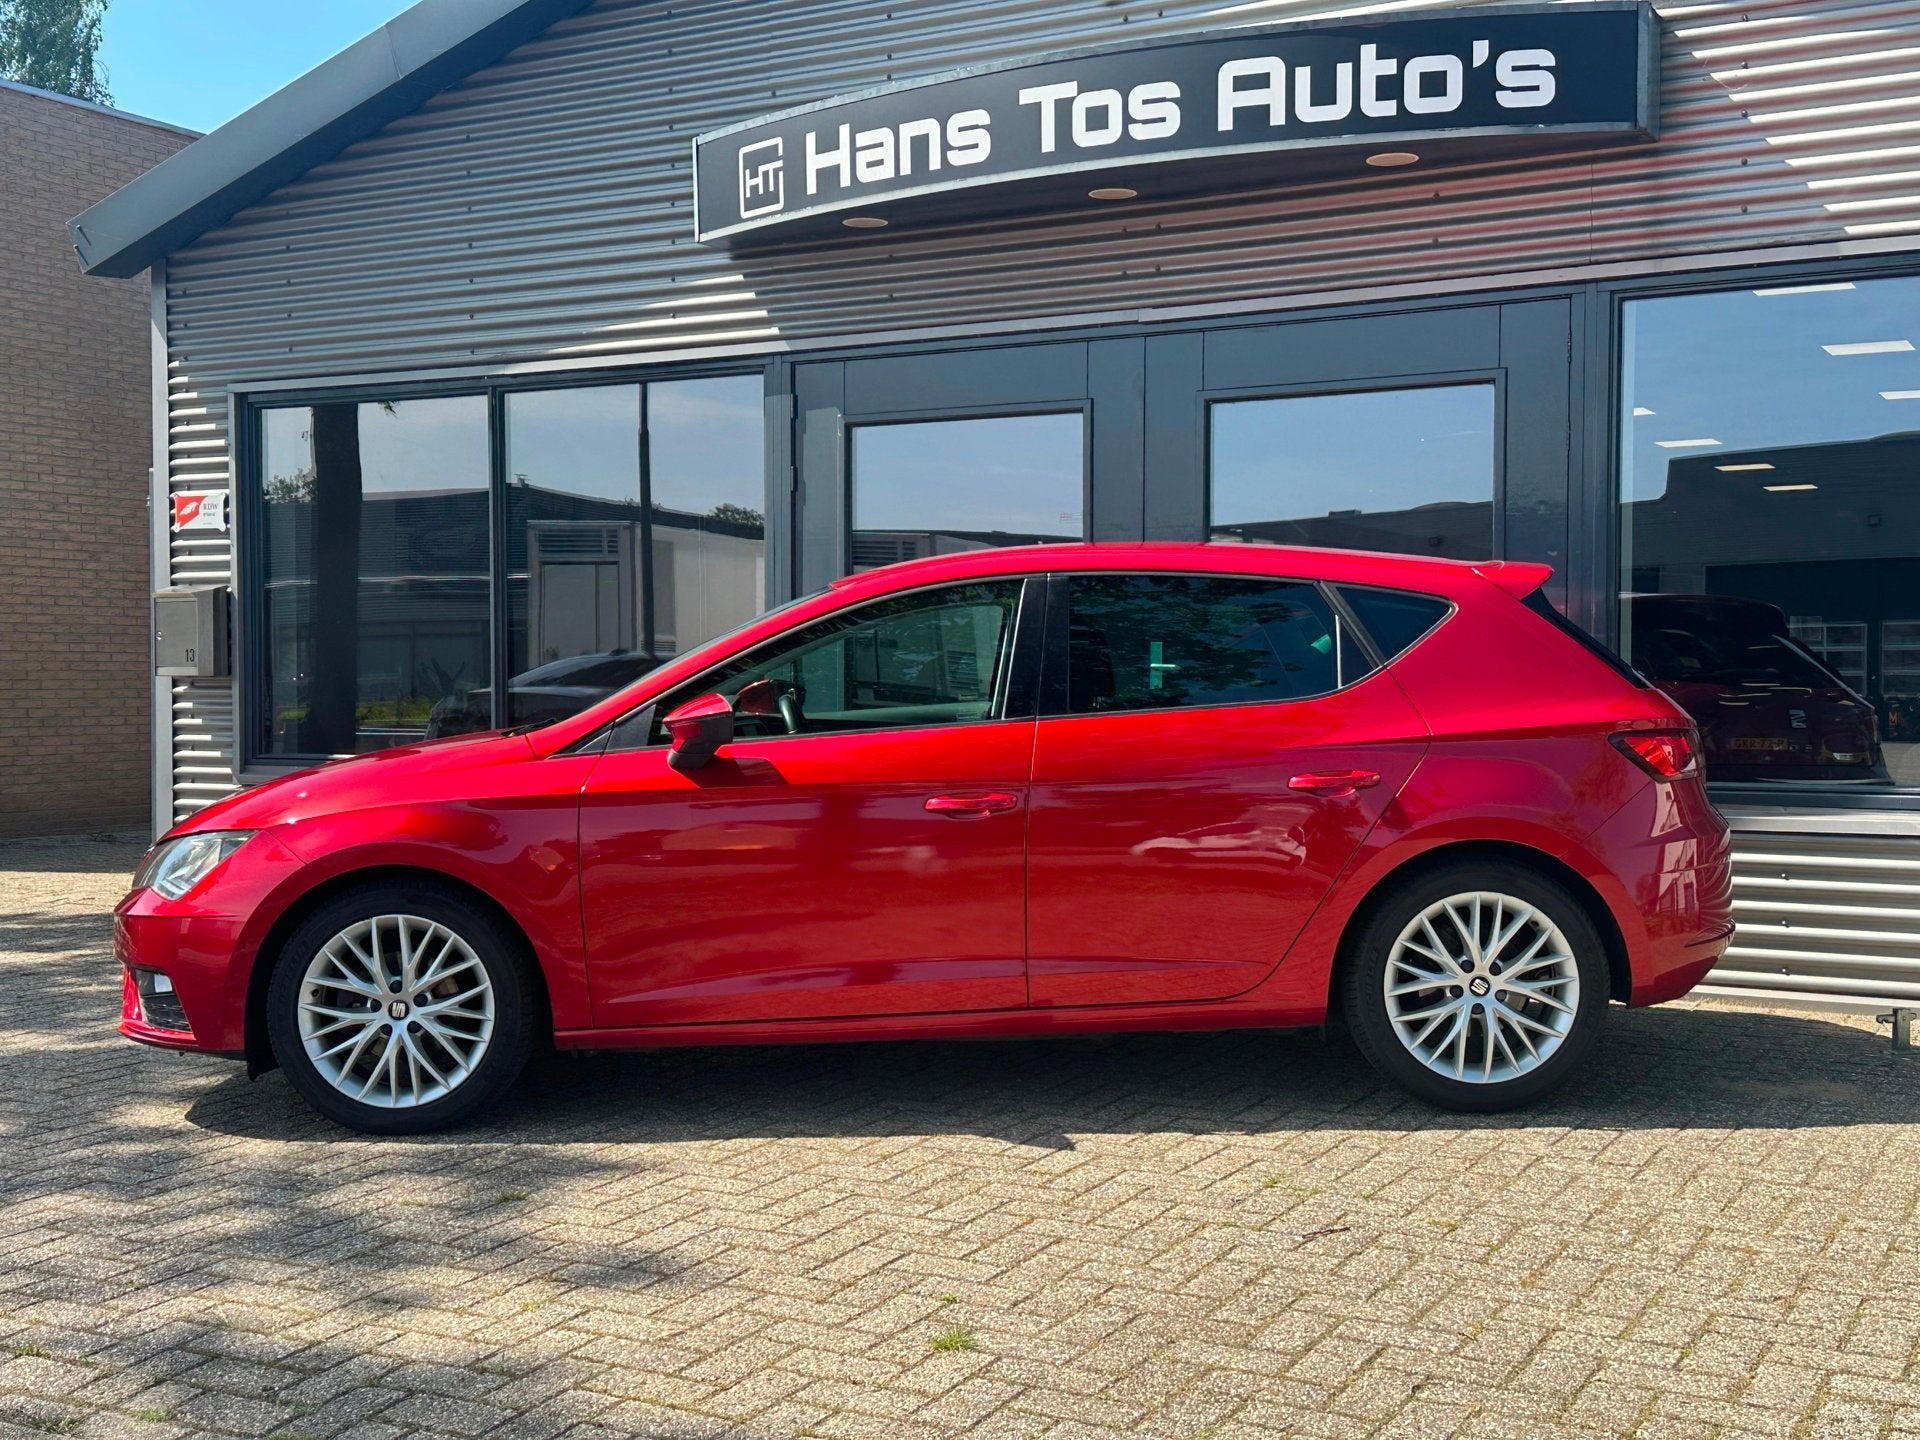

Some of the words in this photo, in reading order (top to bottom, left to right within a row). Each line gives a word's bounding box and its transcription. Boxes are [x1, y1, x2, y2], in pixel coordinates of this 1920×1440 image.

[805, 108, 992, 196] Hans
[1018, 80, 1181, 154] Tos
[1217, 39, 1556, 132] Auto's
[185, 648, 195, 663] 13
